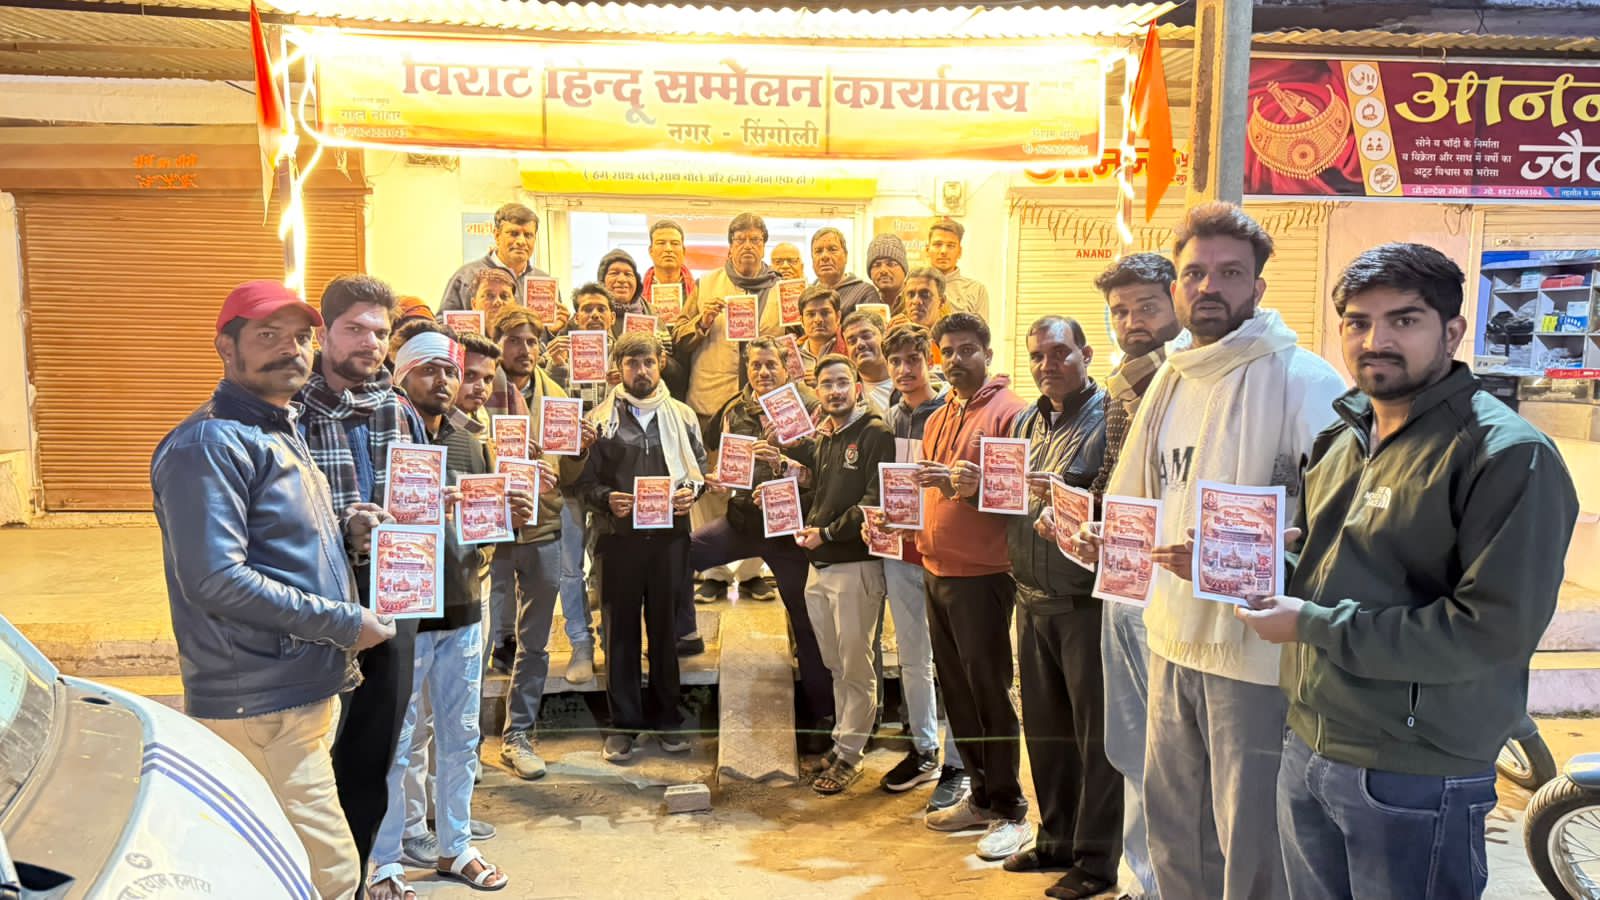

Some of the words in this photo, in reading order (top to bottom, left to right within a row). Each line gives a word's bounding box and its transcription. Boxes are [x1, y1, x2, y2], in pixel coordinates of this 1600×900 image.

[401, 54, 533, 98] विराट
[544, 58, 656, 125] हिन्दू
[654, 57, 823, 107] सम्मेलन
[833, 64, 1029, 113] कार्यालय
[666, 122, 712, 143] नगर
[739, 118, 819, 145] सिंगोली
[1415, 136, 1431, 148] सोने
[1463, 137, 1471, 148] के
[1439, 151, 1453, 162] और
[1501, 155, 1512, 163] का
[1076, 248, 1112, 259] ANAND
